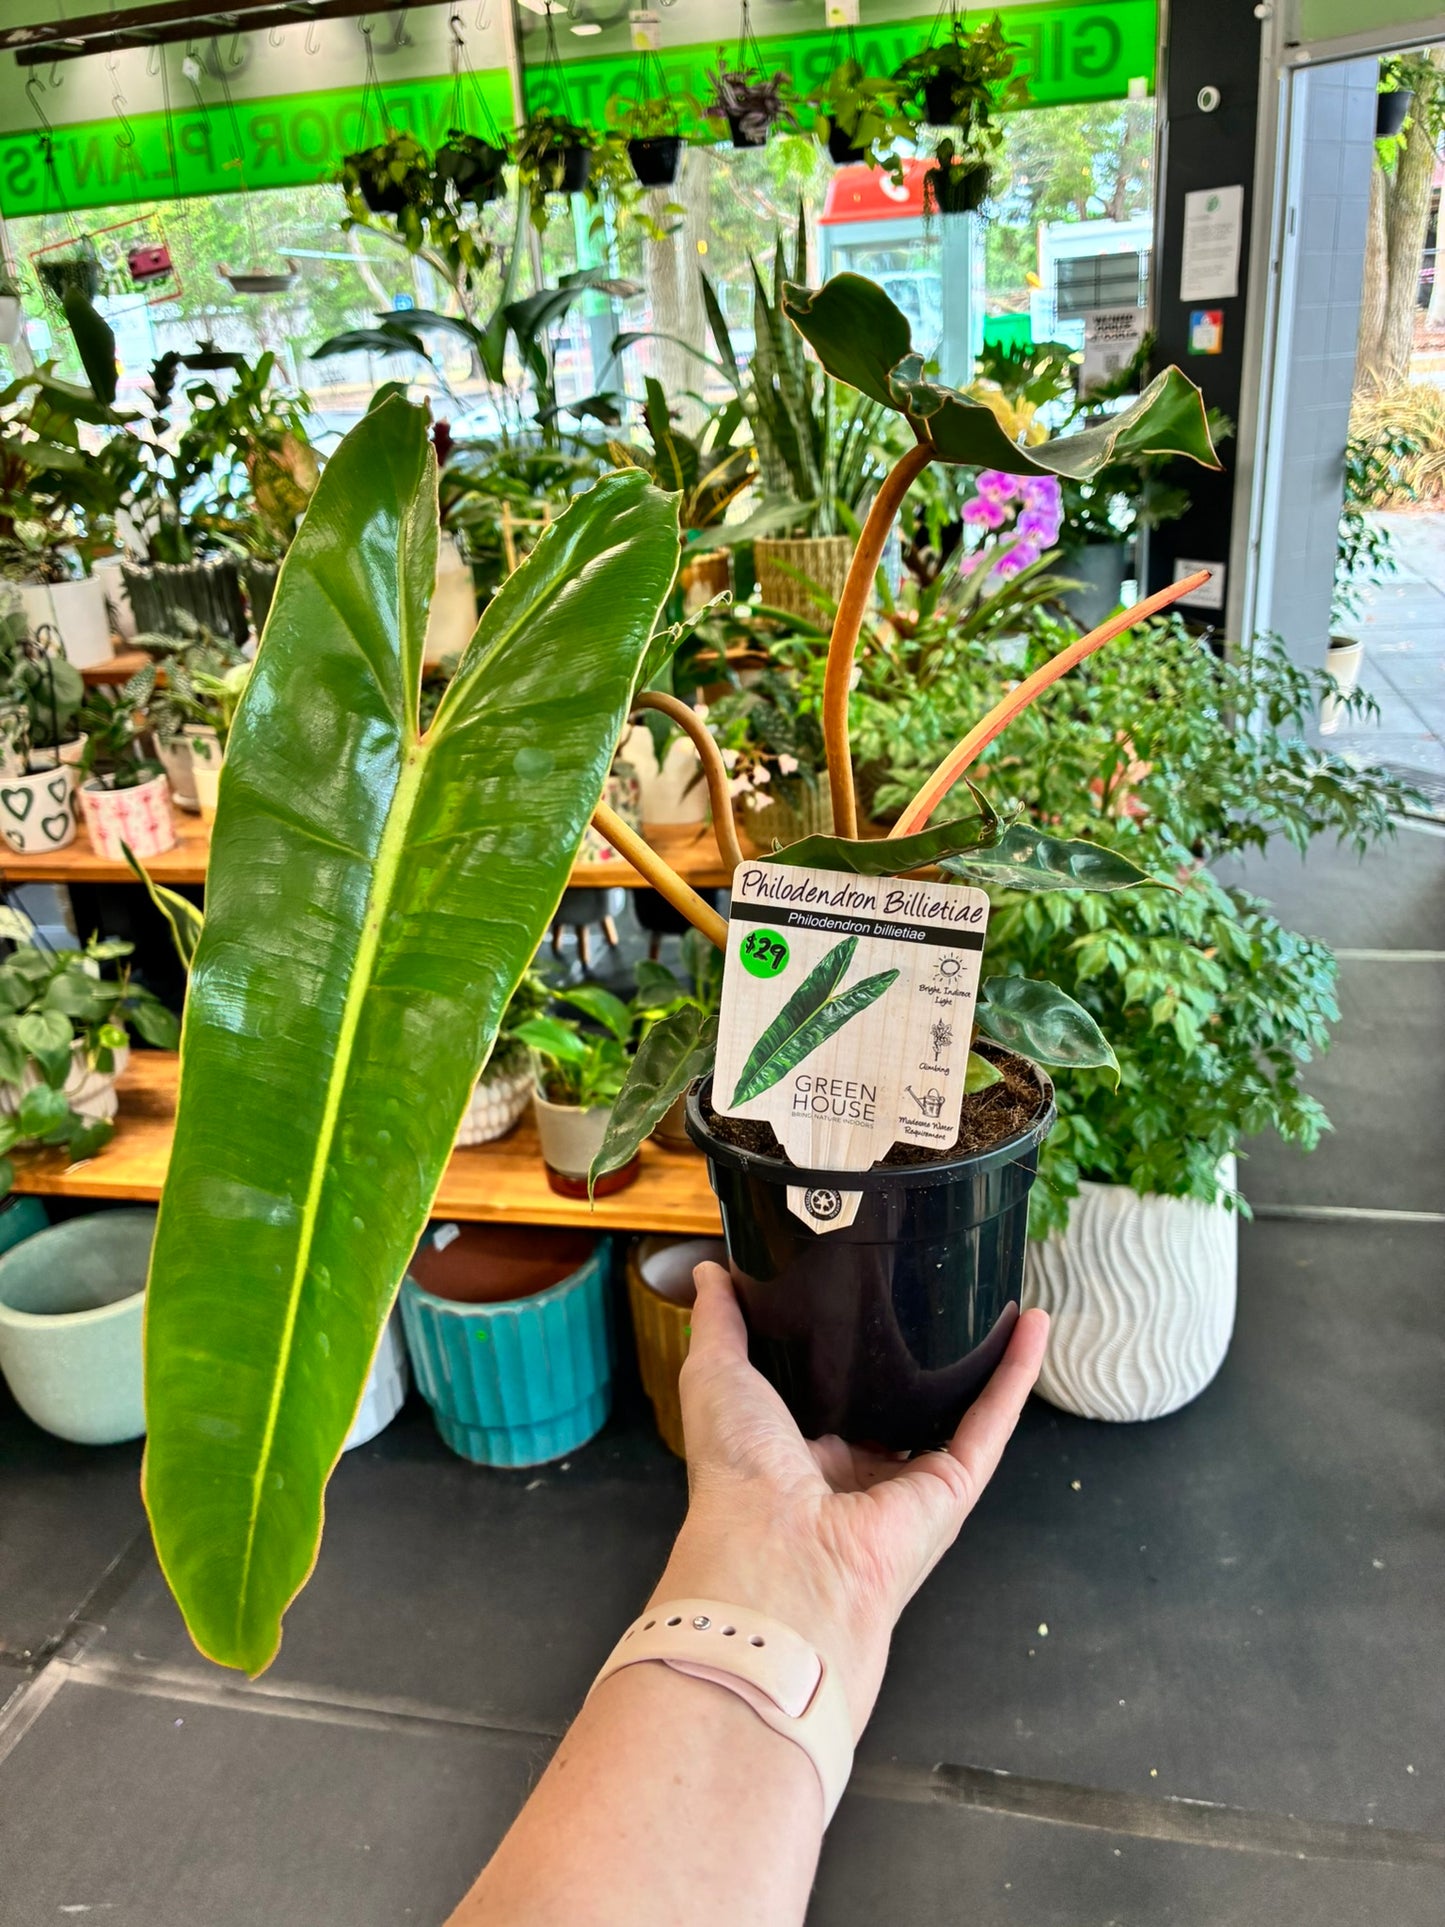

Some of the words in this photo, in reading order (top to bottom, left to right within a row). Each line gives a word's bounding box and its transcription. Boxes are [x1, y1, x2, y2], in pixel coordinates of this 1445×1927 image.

[741, 869, 876, 911] Philodendron
[883, 890, 983, 924] Billietiae
[787, 912, 871, 933] Philodendron
[874, 923, 926, 941] billietiae
[745, 932, 787, 970] $29
[918, 984, 942, 996] Bright
[943, 986, 971, 998] Indirect
[934, 996, 953, 1007] Light
[919, 1062, 950, 1076] Climbing
[795, 1074, 877, 1103] GREEN
[792, 1093, 876, 1122] HOUSE
[791, 1111, 813, 1119] BRING
[813, 1113, 841, 1123] NATURE
[842, 1118, 875, 1130] INDOORS
[931, 1121, 955, 1132] Water
[904, 1126, 946, 1141] Requirement
